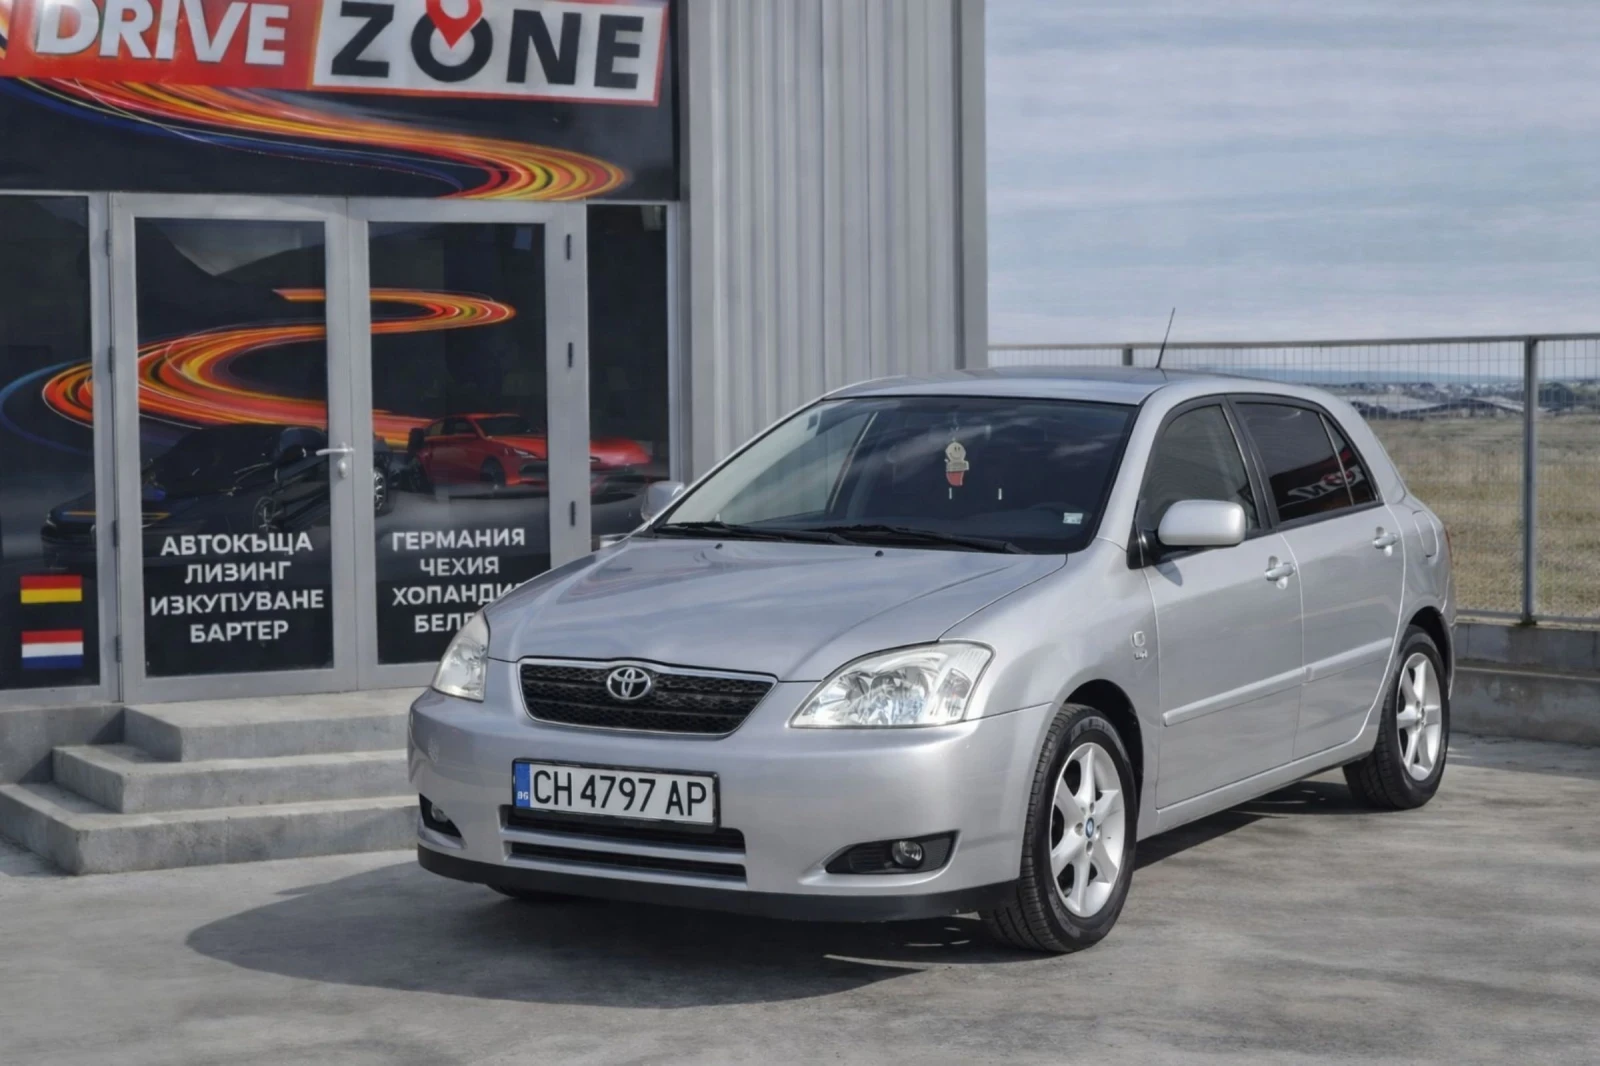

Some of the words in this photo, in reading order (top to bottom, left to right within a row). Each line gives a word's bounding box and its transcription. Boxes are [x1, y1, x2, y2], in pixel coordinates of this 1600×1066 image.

[35, 0, 289, 65] DRIVE
[331, 1, 644, 90] ZONE
[160, 531, 313, 556] АВТОКЪЩА
[392, 528, 525, 552] ГЕРМАНИЯ
[184, 561, 292, 584] ЛИЗИНГ
[420, 556, 500, 577] ЧЕХИЯ
[150, 589, 325, 616] ИЗКУПУВАНЕ
[392, 583, 524, 606] ХОПАНДИ
[190, 620, 289, 643] БАРТЕР
[414, 612, 477, 633] БЕЛГ
[516, 791, 529, 800] BG
[533, 770, 572, 807] CH
[580, 774, 656, 812] 4797
[665, 780, 707, 816] AP
